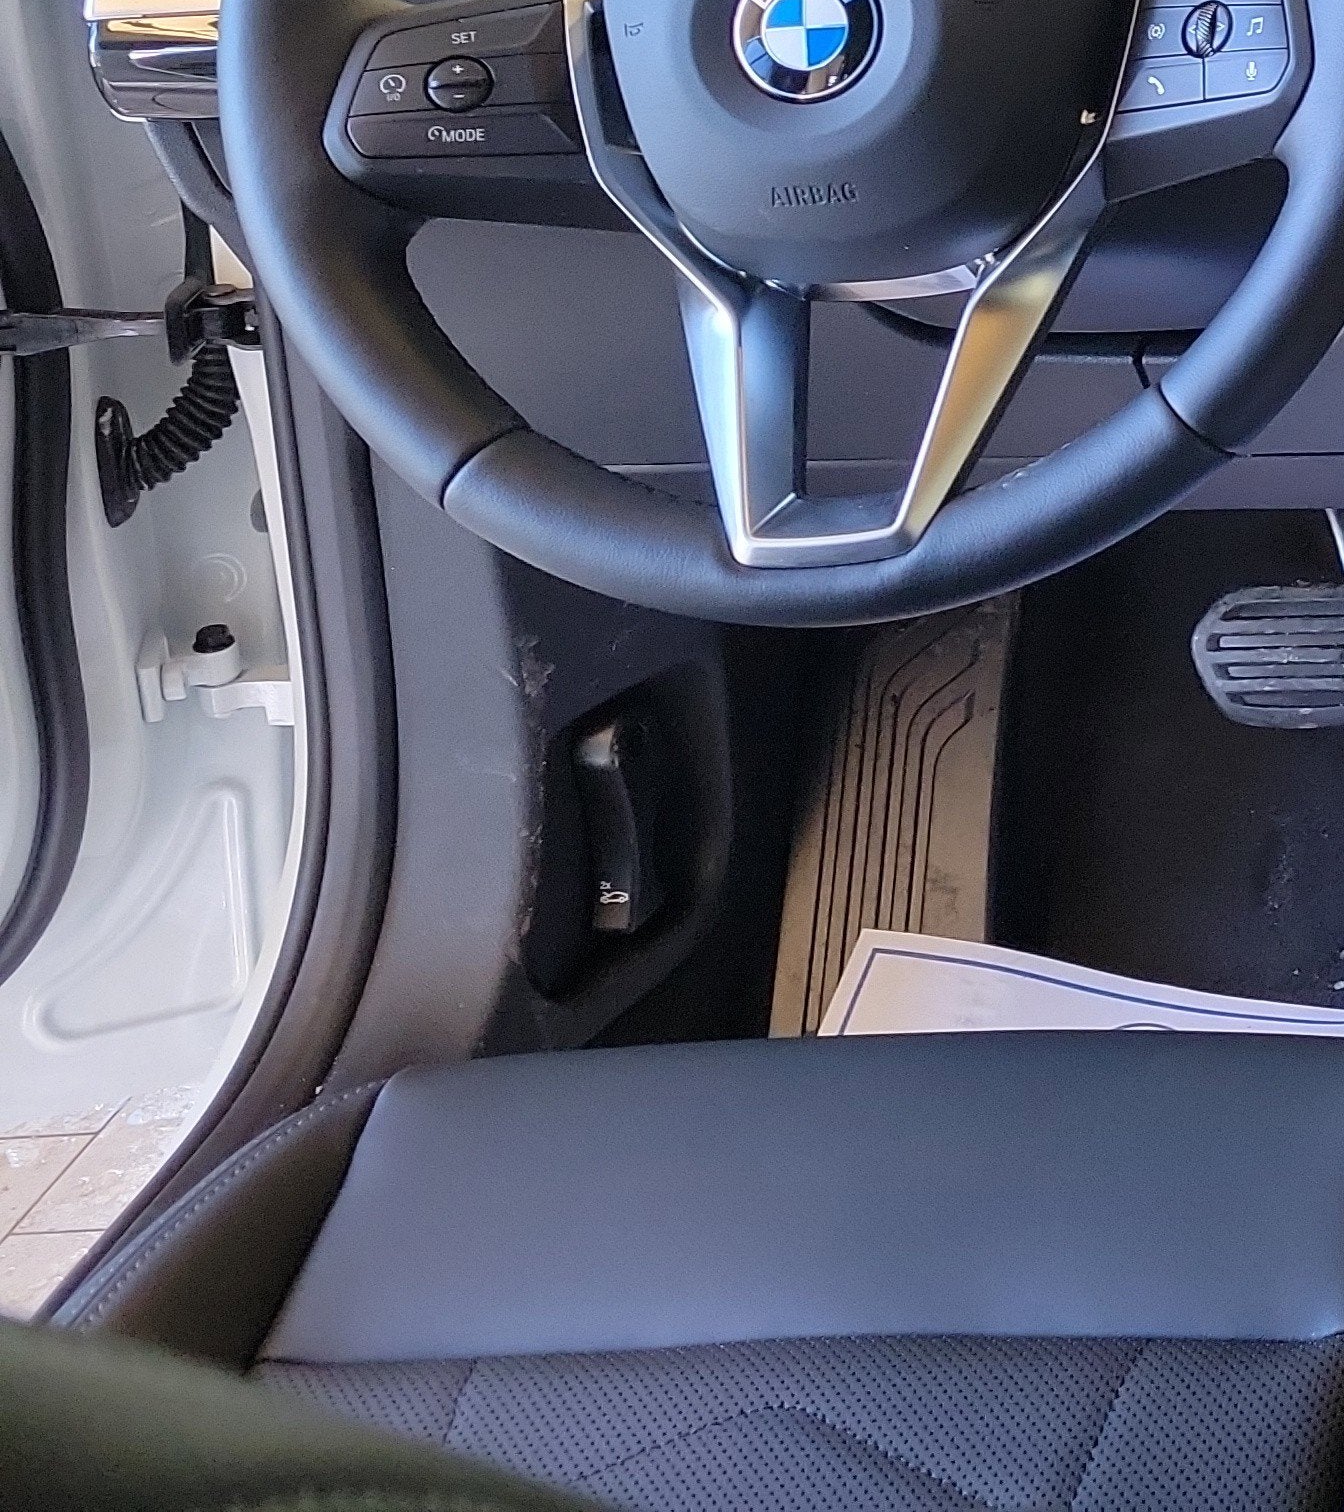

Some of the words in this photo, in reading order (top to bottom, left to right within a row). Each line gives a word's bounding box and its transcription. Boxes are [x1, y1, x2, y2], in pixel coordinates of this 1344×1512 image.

[451, 31, 477, 44] SET
[441, 128, 485, 143] MODE
[770, 183, 858, 207] AIRBAG
[600, 881, 611, 889] 2x
